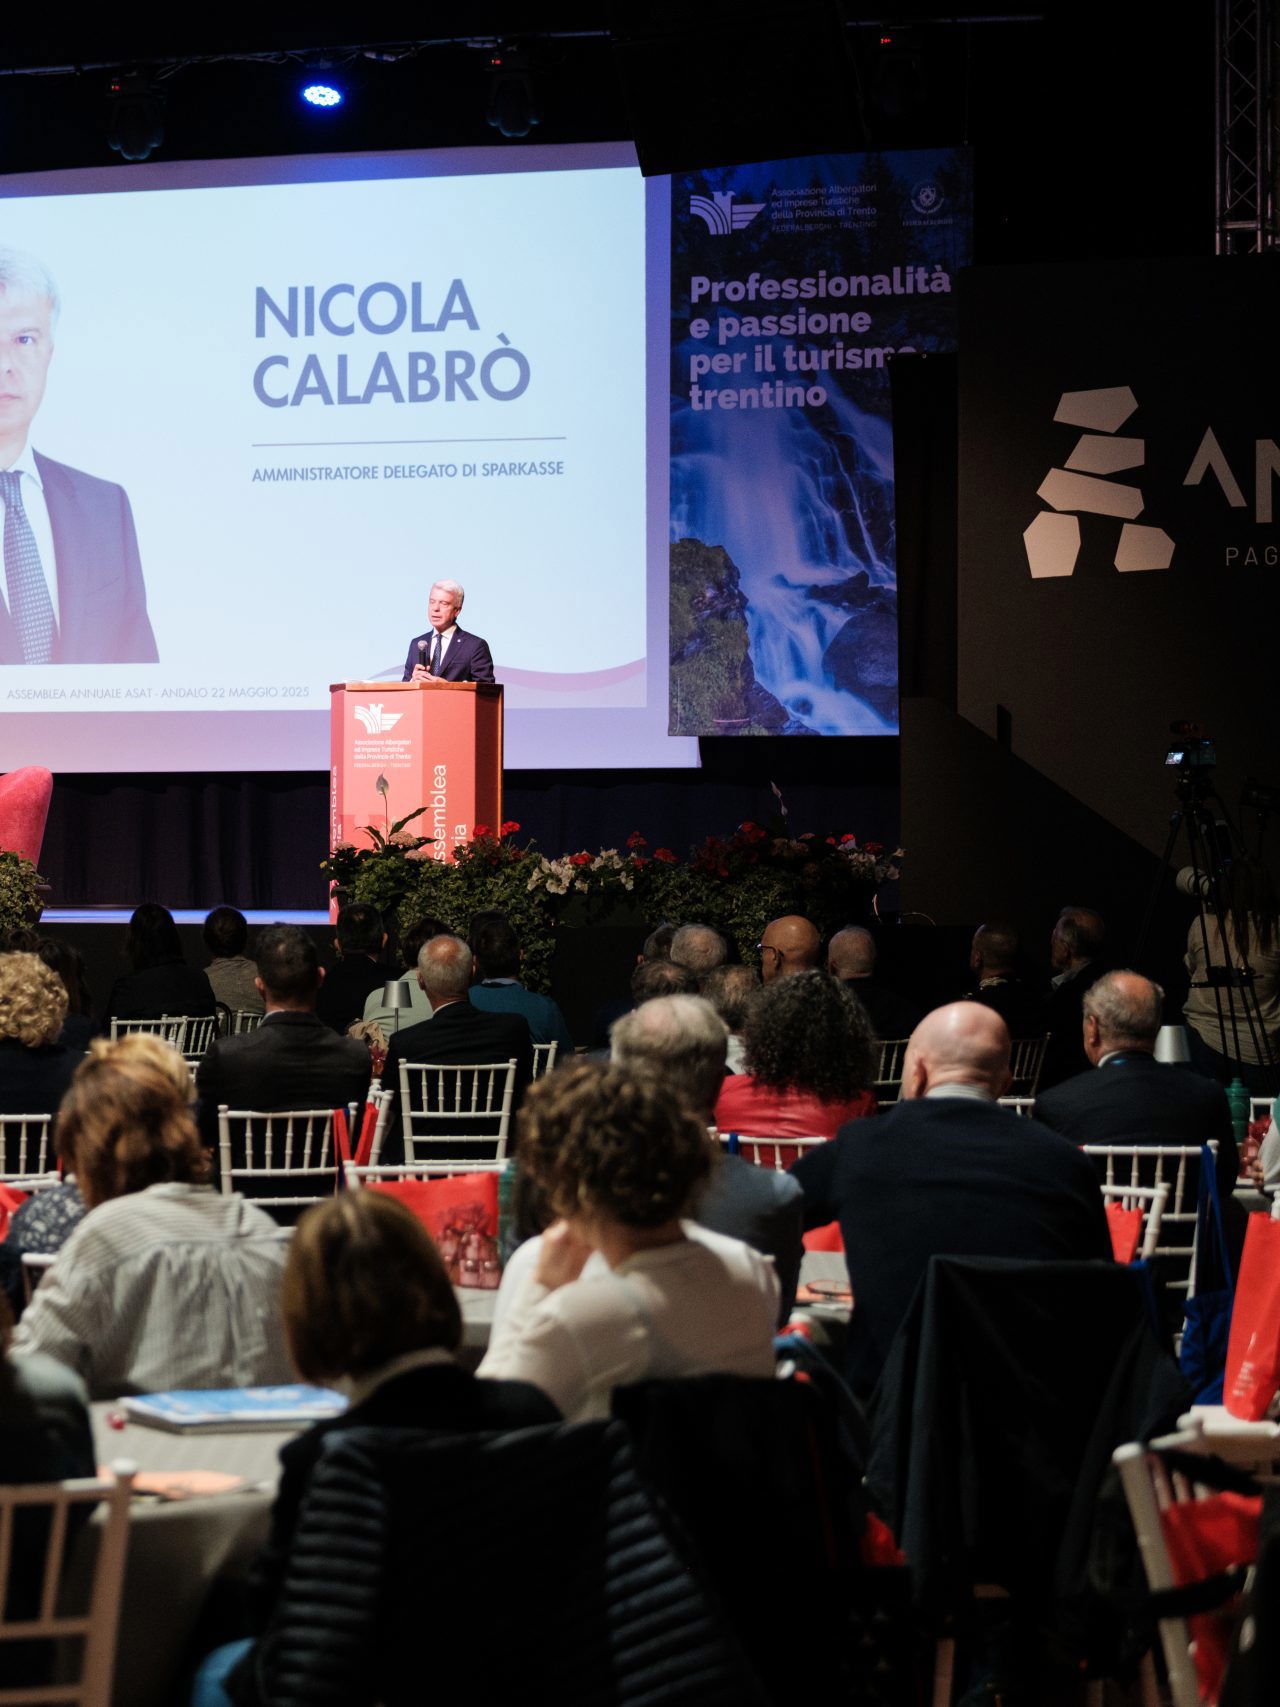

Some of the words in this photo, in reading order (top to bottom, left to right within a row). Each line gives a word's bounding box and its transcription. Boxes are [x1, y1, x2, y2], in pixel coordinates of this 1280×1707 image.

[829, 184, 877, 196] Albergatori
[771, 210, 794, 220] della
[795, 208, 835, 219] Provincia
[836, 207, 846, 216] di
[847, 206, 877, 216] Trento
[690, 264, 952, 303] Professionalità
[255, 278, 480, 338] NICOLA
[689, 317, 710, 339] e
[718, 306, 873, 345] passione
[252, 332, 531, 408] CALABRÒ
[690, 352, 747, 382] per
[754, 344, 776, 373] il
[783, 341, 918, 372] turism
[689, 379, 828, 411] trentino
[252, 466, 379, 482] AMMINISTRATORE
[383, 463, 458, 479] DELEGATO
[462, 463, 477, 477] DI
[481, 461, 565, 477] SPARKASSE
[7, 687, 67, 700] ASSEMBLEA
[69, 687, 122, 699] ANNUALE
[125, 686, 153, 699] ASAT
[161, 686, 208, 698] ANDALO
[212, 686, 226, 698] 22
[228, 685, 278, 698] MAGGIO
[281, 685, 310, 698] 2025
[430, 764, 447, 865] ssemblea
